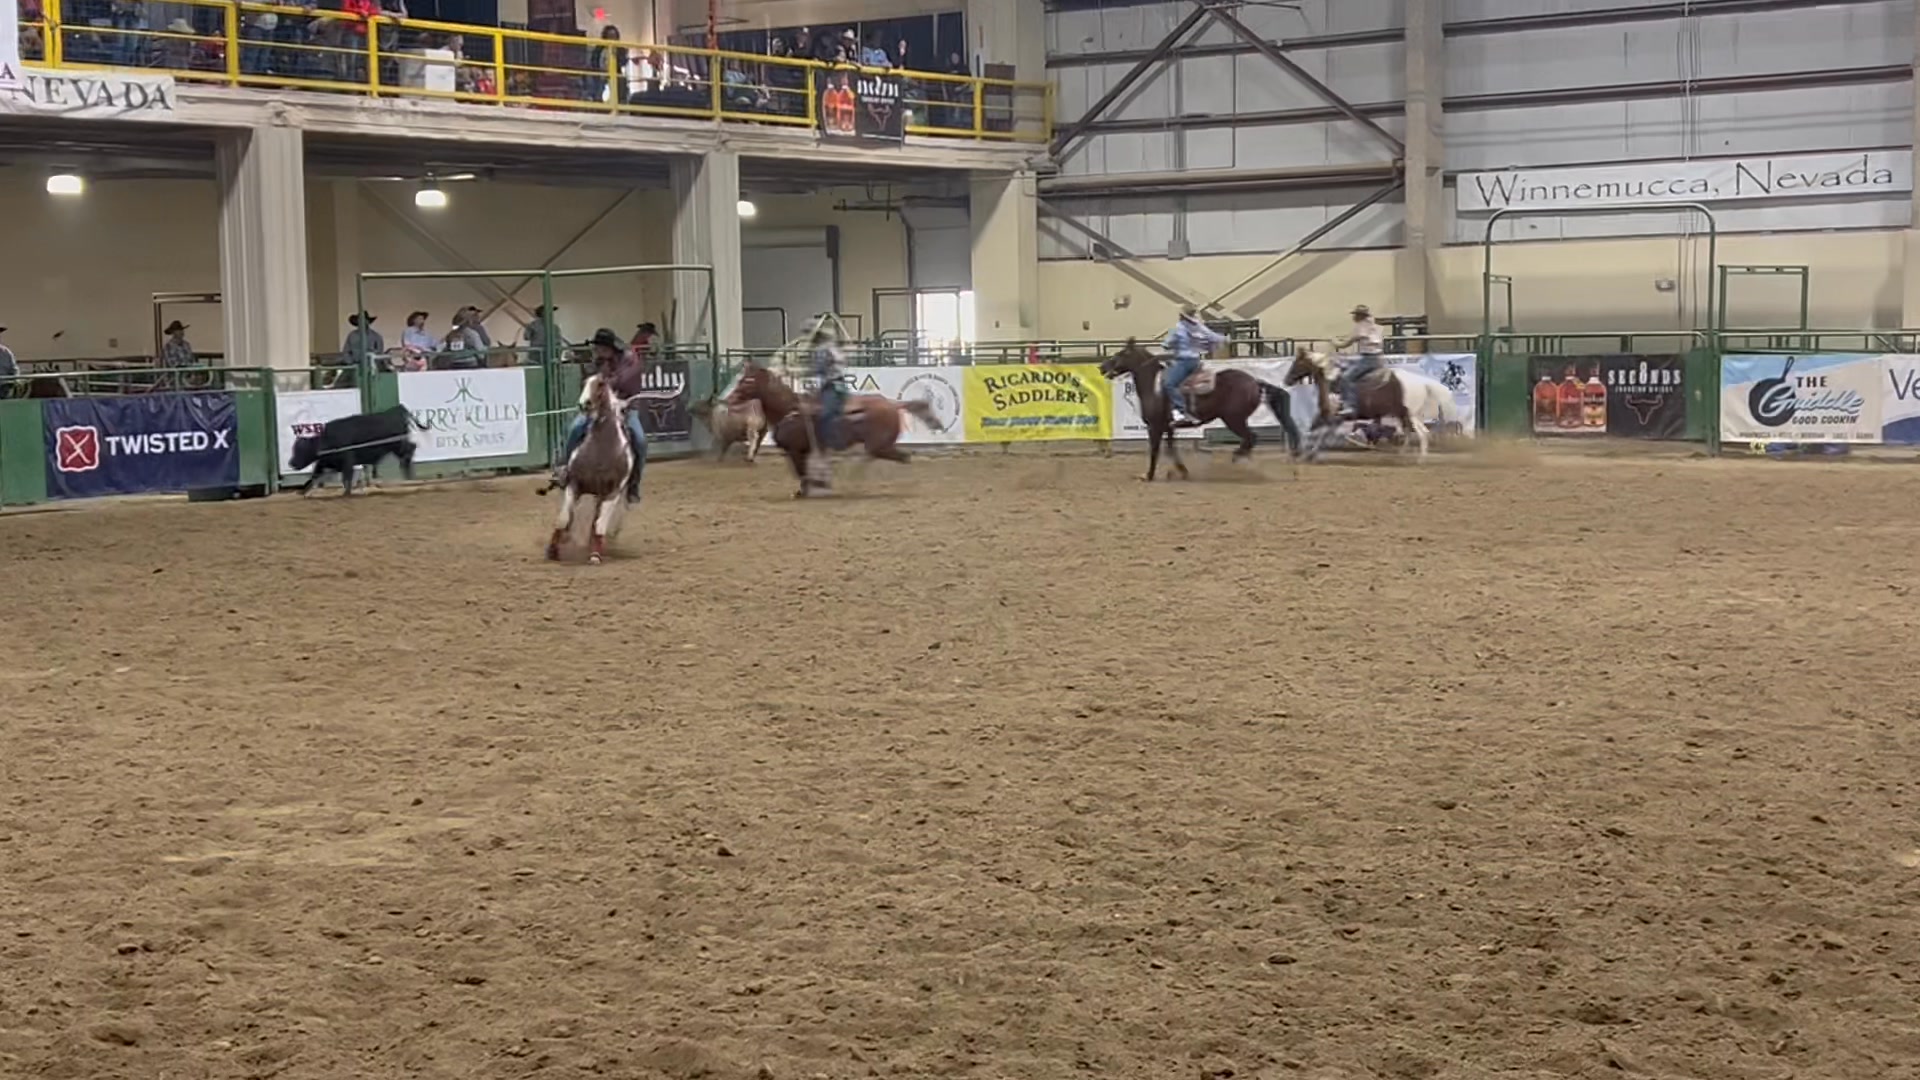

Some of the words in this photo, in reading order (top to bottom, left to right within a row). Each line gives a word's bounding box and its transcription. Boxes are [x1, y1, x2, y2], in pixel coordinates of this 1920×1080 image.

[13, 75, 173, 111] NEVADA
[1476, 172, 1720, 207] Winnemucca,
[1736, 154, 1893, 195] Nevada
[984, 371, 1080, 394] RICARDO'S
[1796, 375, 1828, 388] THE
[993, 389, 1088, 411] SADDLERY
[1758, 381, 1864, 418] Griddle
[1792, 416, 1818, 424] GOOD
[105, 431, 208, 456] TWISTED
[213, 428, 231, 449] X
[461, 432, 472, 448] &
